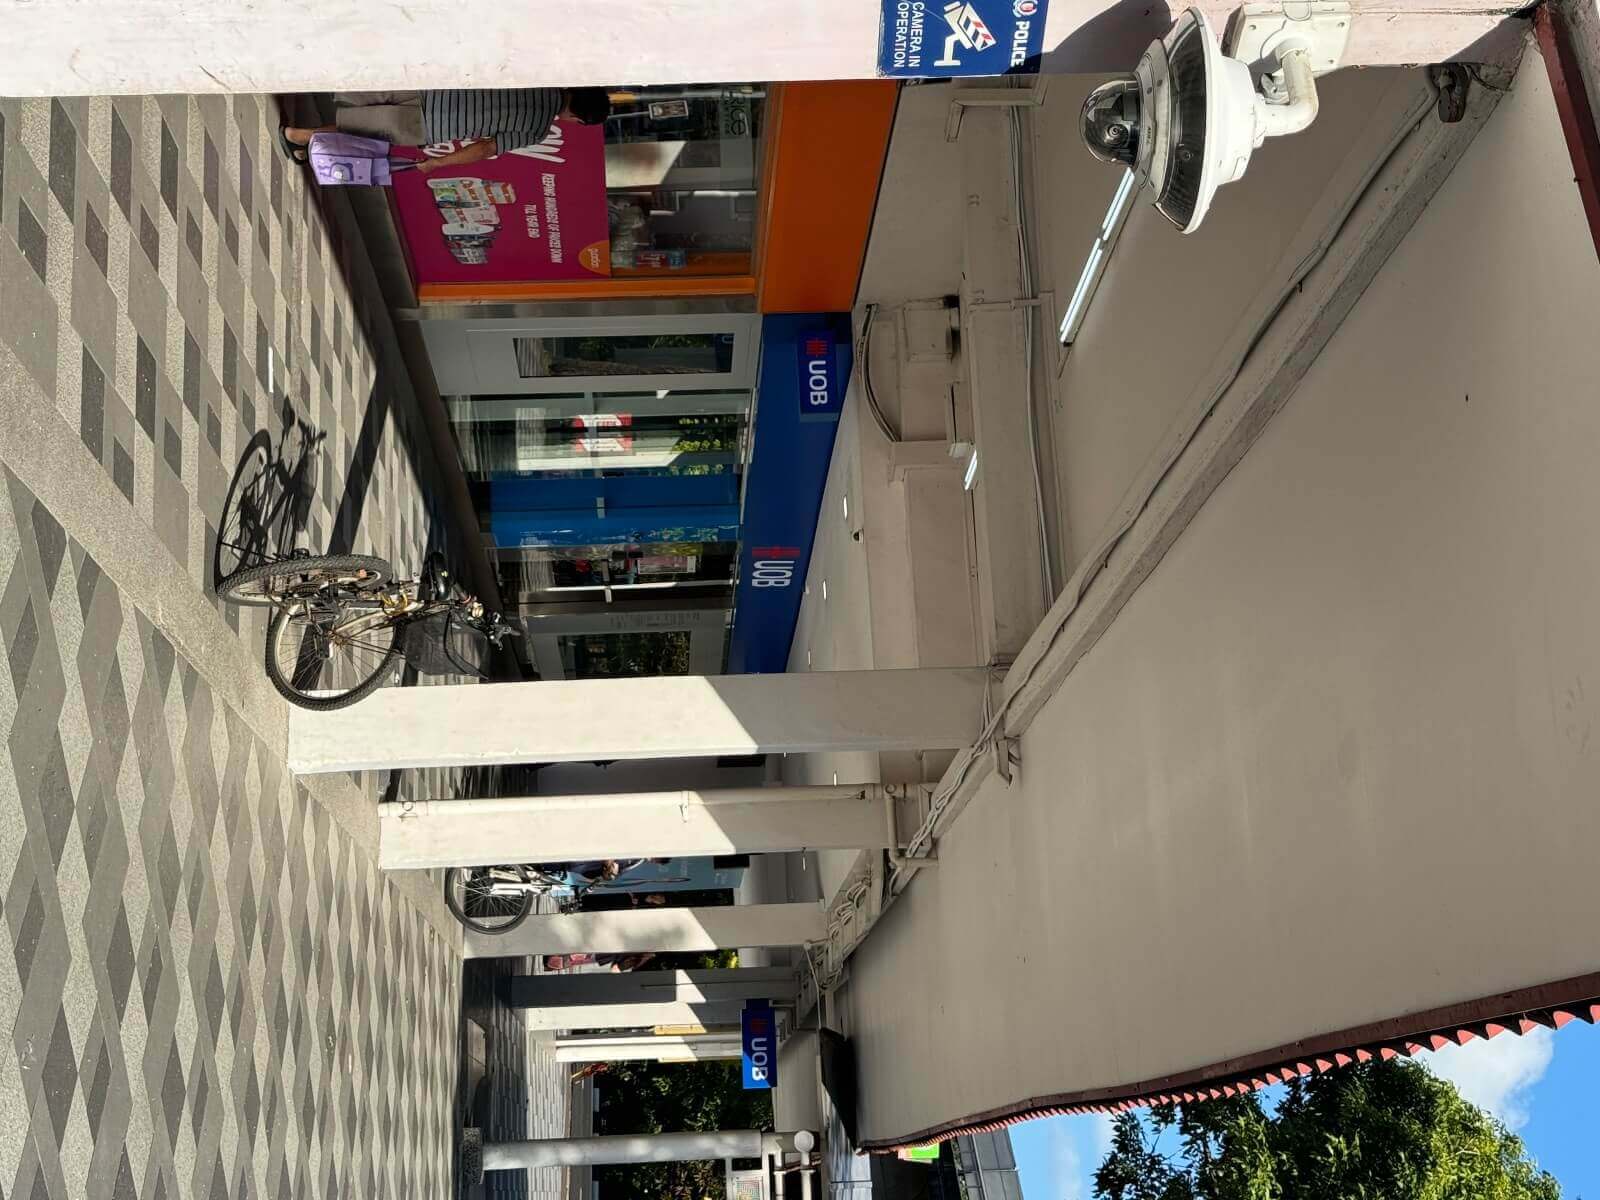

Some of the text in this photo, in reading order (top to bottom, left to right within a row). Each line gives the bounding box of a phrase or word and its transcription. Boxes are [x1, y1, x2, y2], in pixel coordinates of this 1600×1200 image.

[893, 2, 909, 67] OPERATION
[908, 2, 925, 67] CAMERA IN
[1010, 21, 1030, 67] POLICE
[541, 173, 556, 196] KEEPING
[809, 360, 828, 405] UOB
[752, 560, 795, 587] UOB
[751, 1037, 768, 1081] UOB
